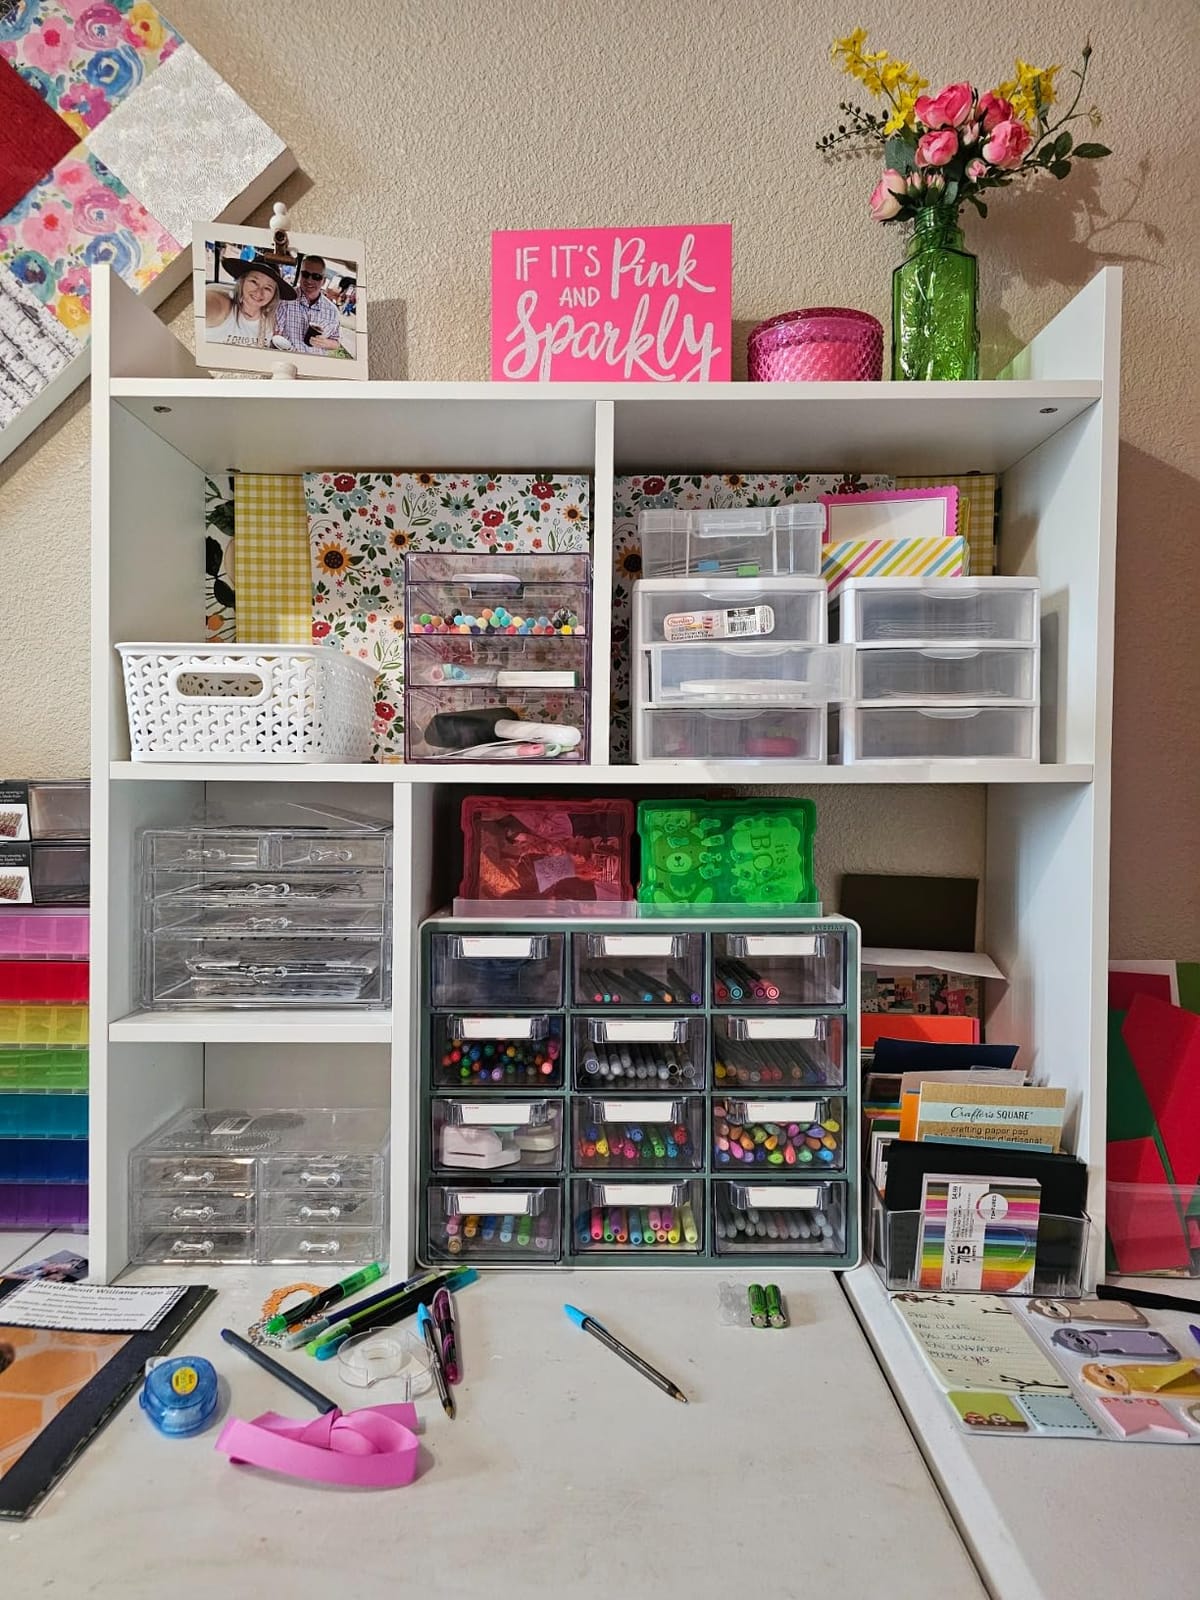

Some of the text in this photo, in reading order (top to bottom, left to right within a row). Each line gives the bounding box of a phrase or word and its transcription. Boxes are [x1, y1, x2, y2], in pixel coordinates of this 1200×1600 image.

[515, 233, 716, 299] IF IT'S Pink
[559, 286, 601, 308] AND
[502, 290, 722, 383] Sparkly
[950, 1107, 1030, 1122] Crafter's SQUARE
[951, 1126, 1029, 1136] crafting paper pad
[957, 1246, 971, 1264] 75
